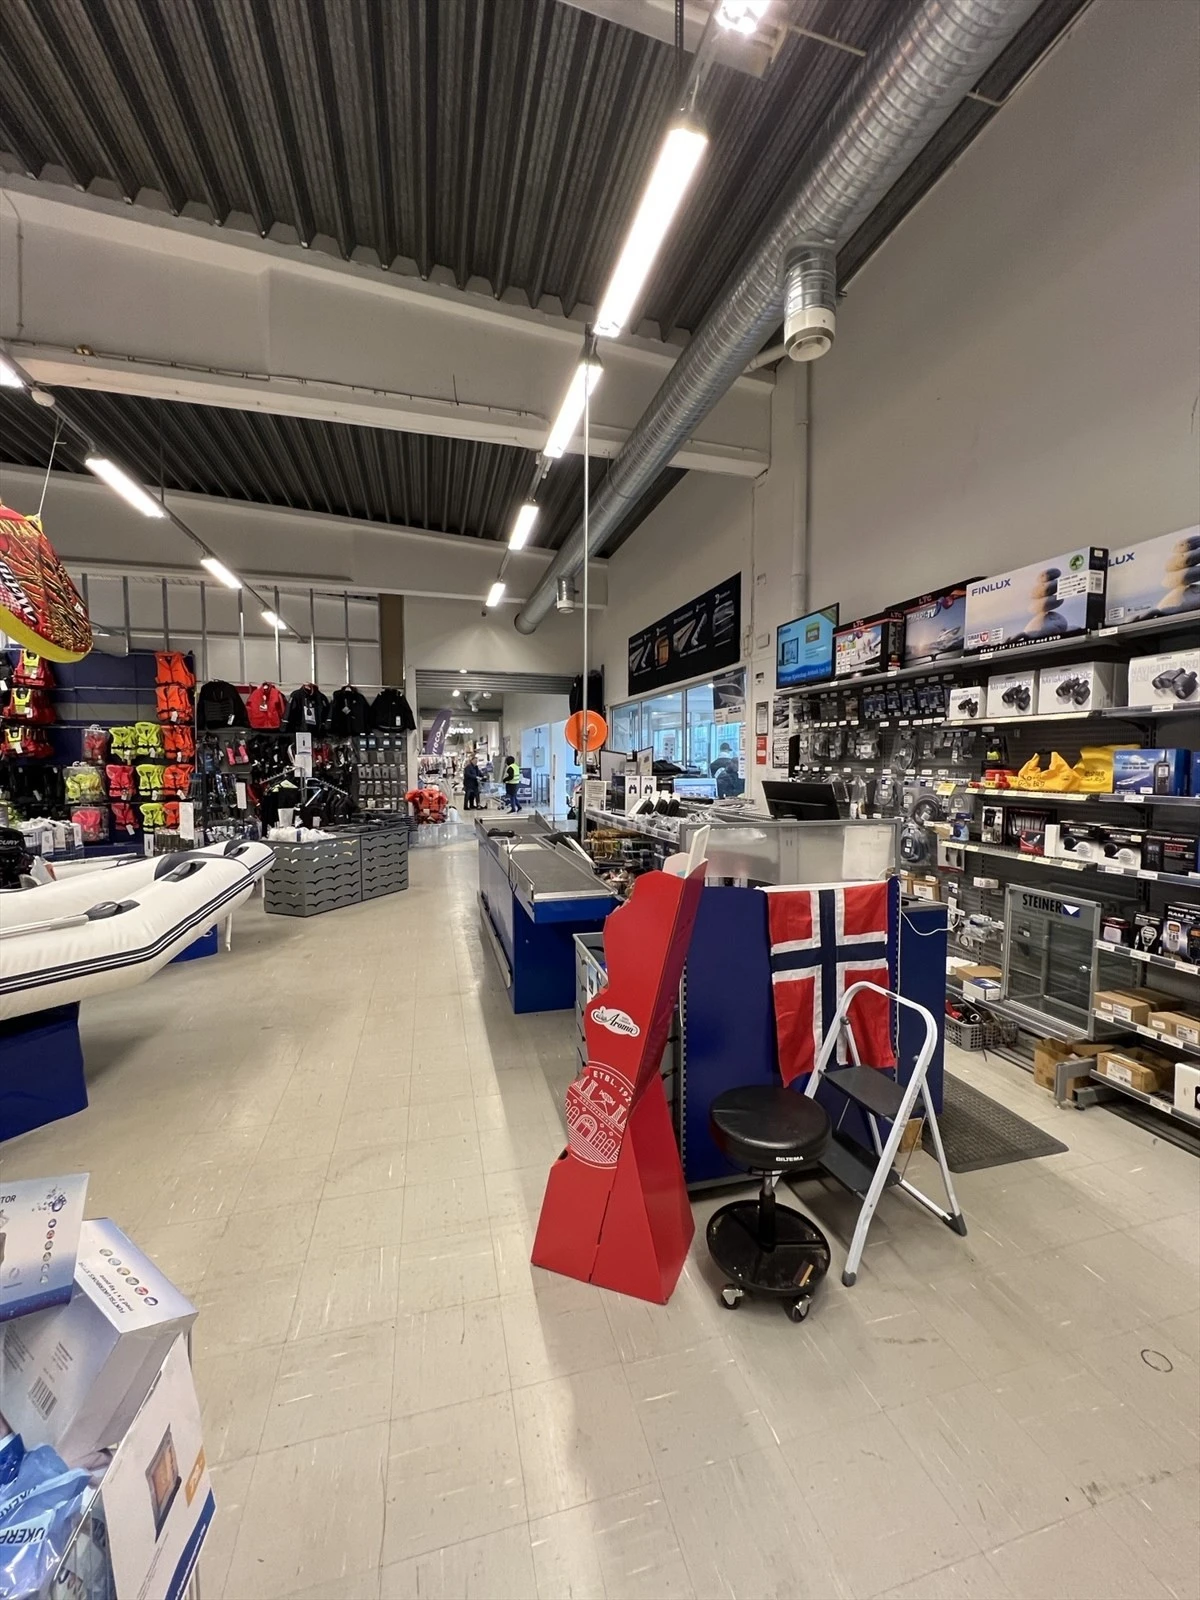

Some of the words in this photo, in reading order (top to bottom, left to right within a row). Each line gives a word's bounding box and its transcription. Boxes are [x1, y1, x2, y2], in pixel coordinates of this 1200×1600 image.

[971, 578, 1011, 596] FINLUX
[919, 595, 932, 605] LTC
[852, 620, 865, 629] LTC
[1022, 893, 1062, 914] STEINER
[607, 1013, 634, 1034] Aroma
[593, 1070, 617, 1088] ETBL.
[619, 1086, 632, 1107] 192
